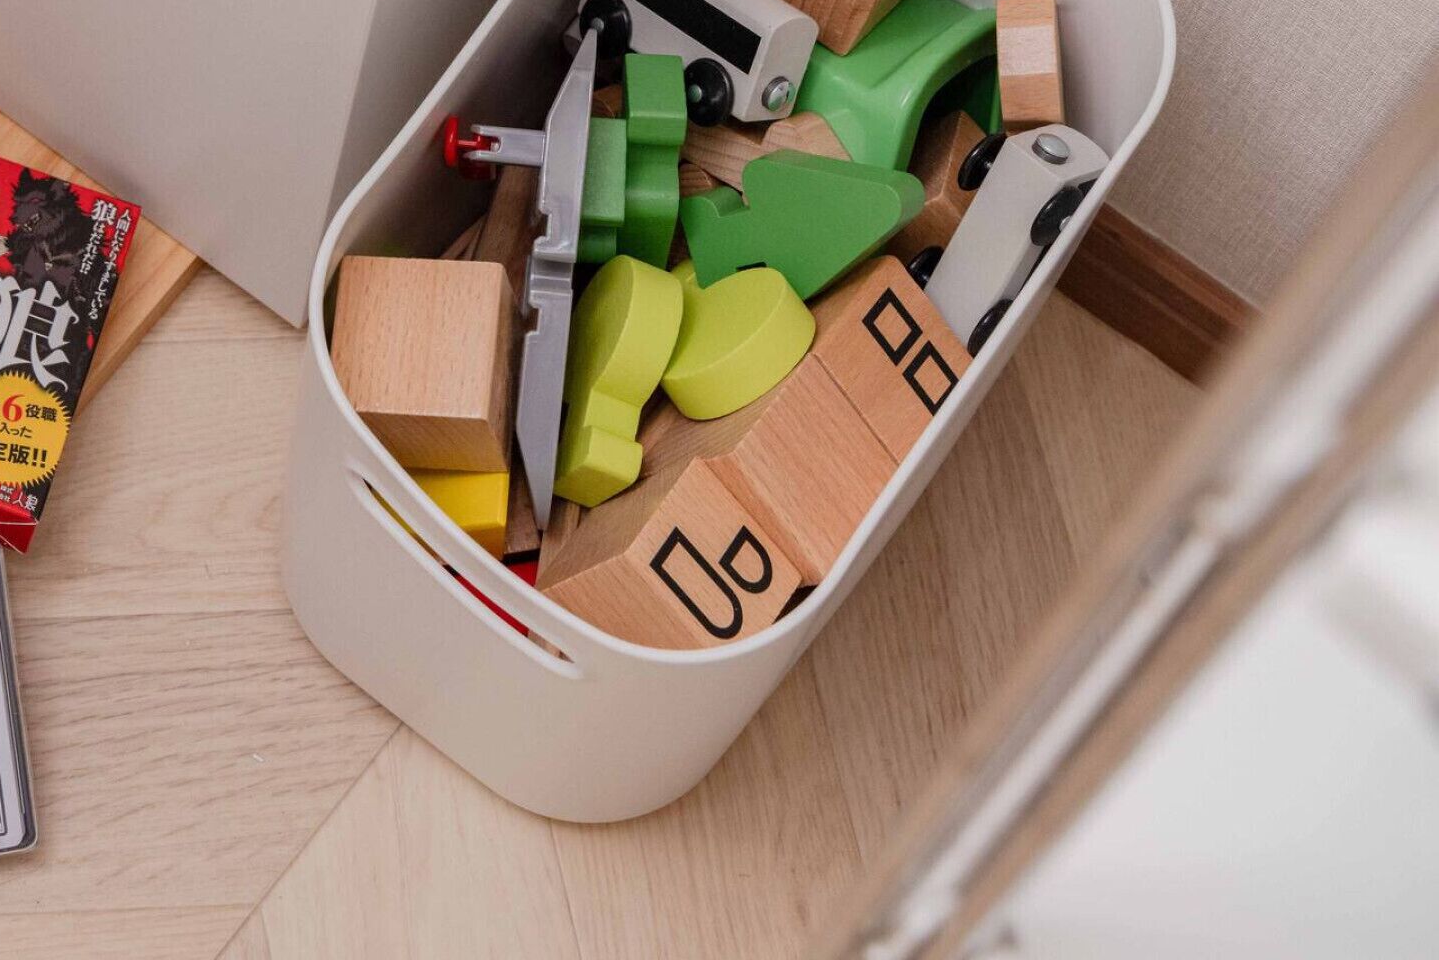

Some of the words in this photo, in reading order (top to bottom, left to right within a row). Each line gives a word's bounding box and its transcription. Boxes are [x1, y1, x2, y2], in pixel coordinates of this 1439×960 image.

[88, 208, 132, 321] 人間になりすましている
